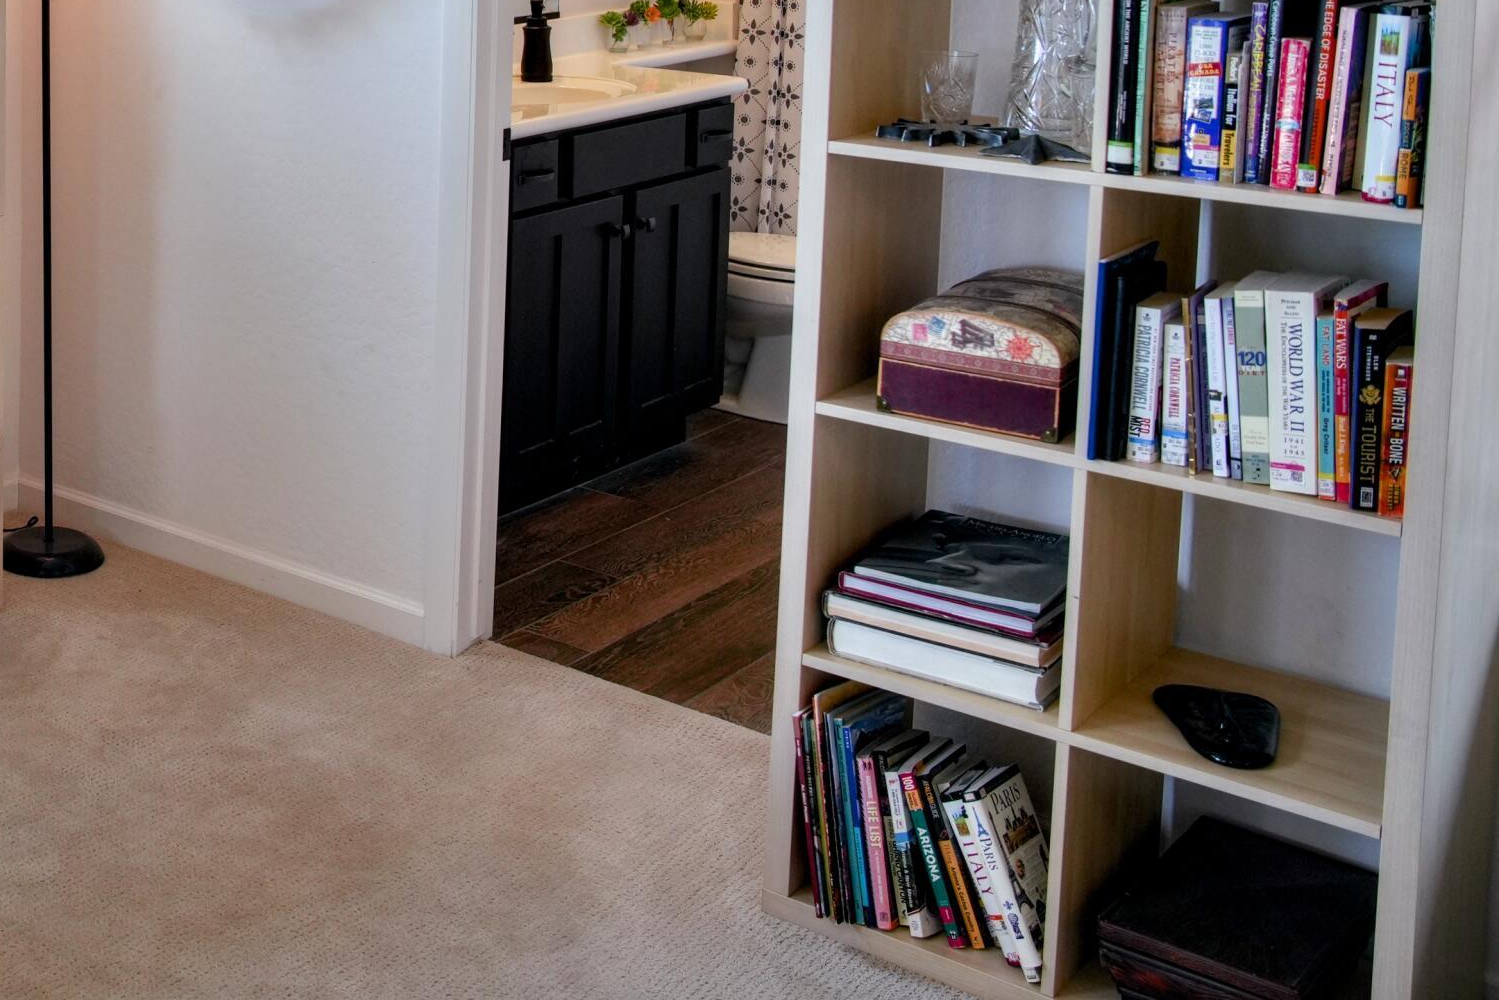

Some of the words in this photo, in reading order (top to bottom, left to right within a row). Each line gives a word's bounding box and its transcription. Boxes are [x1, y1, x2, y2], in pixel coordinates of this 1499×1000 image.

[1124, 21, 1132, 44] ANCIENT
[1322, 12, 1334, 37] EDGE
[1167, 32, 1178, 84] PIRATES
[1250, 24, 1266, 92] CARIBBEAN
[1320, 40, 1332, 50] OF
[1189, 68, 1220, 76] CANADA
[1316, 53, 1330, 100] DISASTER
[1227, 88, 1238, 112] Italian
[1374, 62, 1398, 128] ITALY
[1226, 114, 1236, 126] for
[1222, 132, 1234, 166] Travelers
[1398, 152, 1411, 180] ROME
[1336, 318, 1346, 338] FAT
[1134, 324, 1152, 365] PATRICIA
[1288, 322, 1302, 377] WORLD
[1336, 339, 1346, 370] WARS
[1170, 356, 1180, 383] PATRICIA
[1236, 351, 1267, 367] 120
[1132, 366, 1150, 410] CORNWELL
[1168, 384, 1180, 418] CORNWELL
[1290, 378, 1304, 414] WAR
[1365, 408, 1374, 424] THE
[1390, 386, 1406, 430] WRITTEN
[1128, 415, 1140, 438] MIST
[1140, 416, 1151, 434] RED
[1290, 418, 1305, 434] II
[1360, 427, 1376, 484] TOURIST
[1388, 438, 1404, 465] BONE
[902, 776, 914, 791] 100
[866, 801, 878, 825] LIFE
[990, 786, 1021, 816] PARIS
[868, 826, 882, 850] LIST
[917, 826, 940, 882] ARIZONA
[980, 838, 998, 872] PARIS
[949, 866, 962, 892] Arizona's
[962, 911, 976, 933] Country
